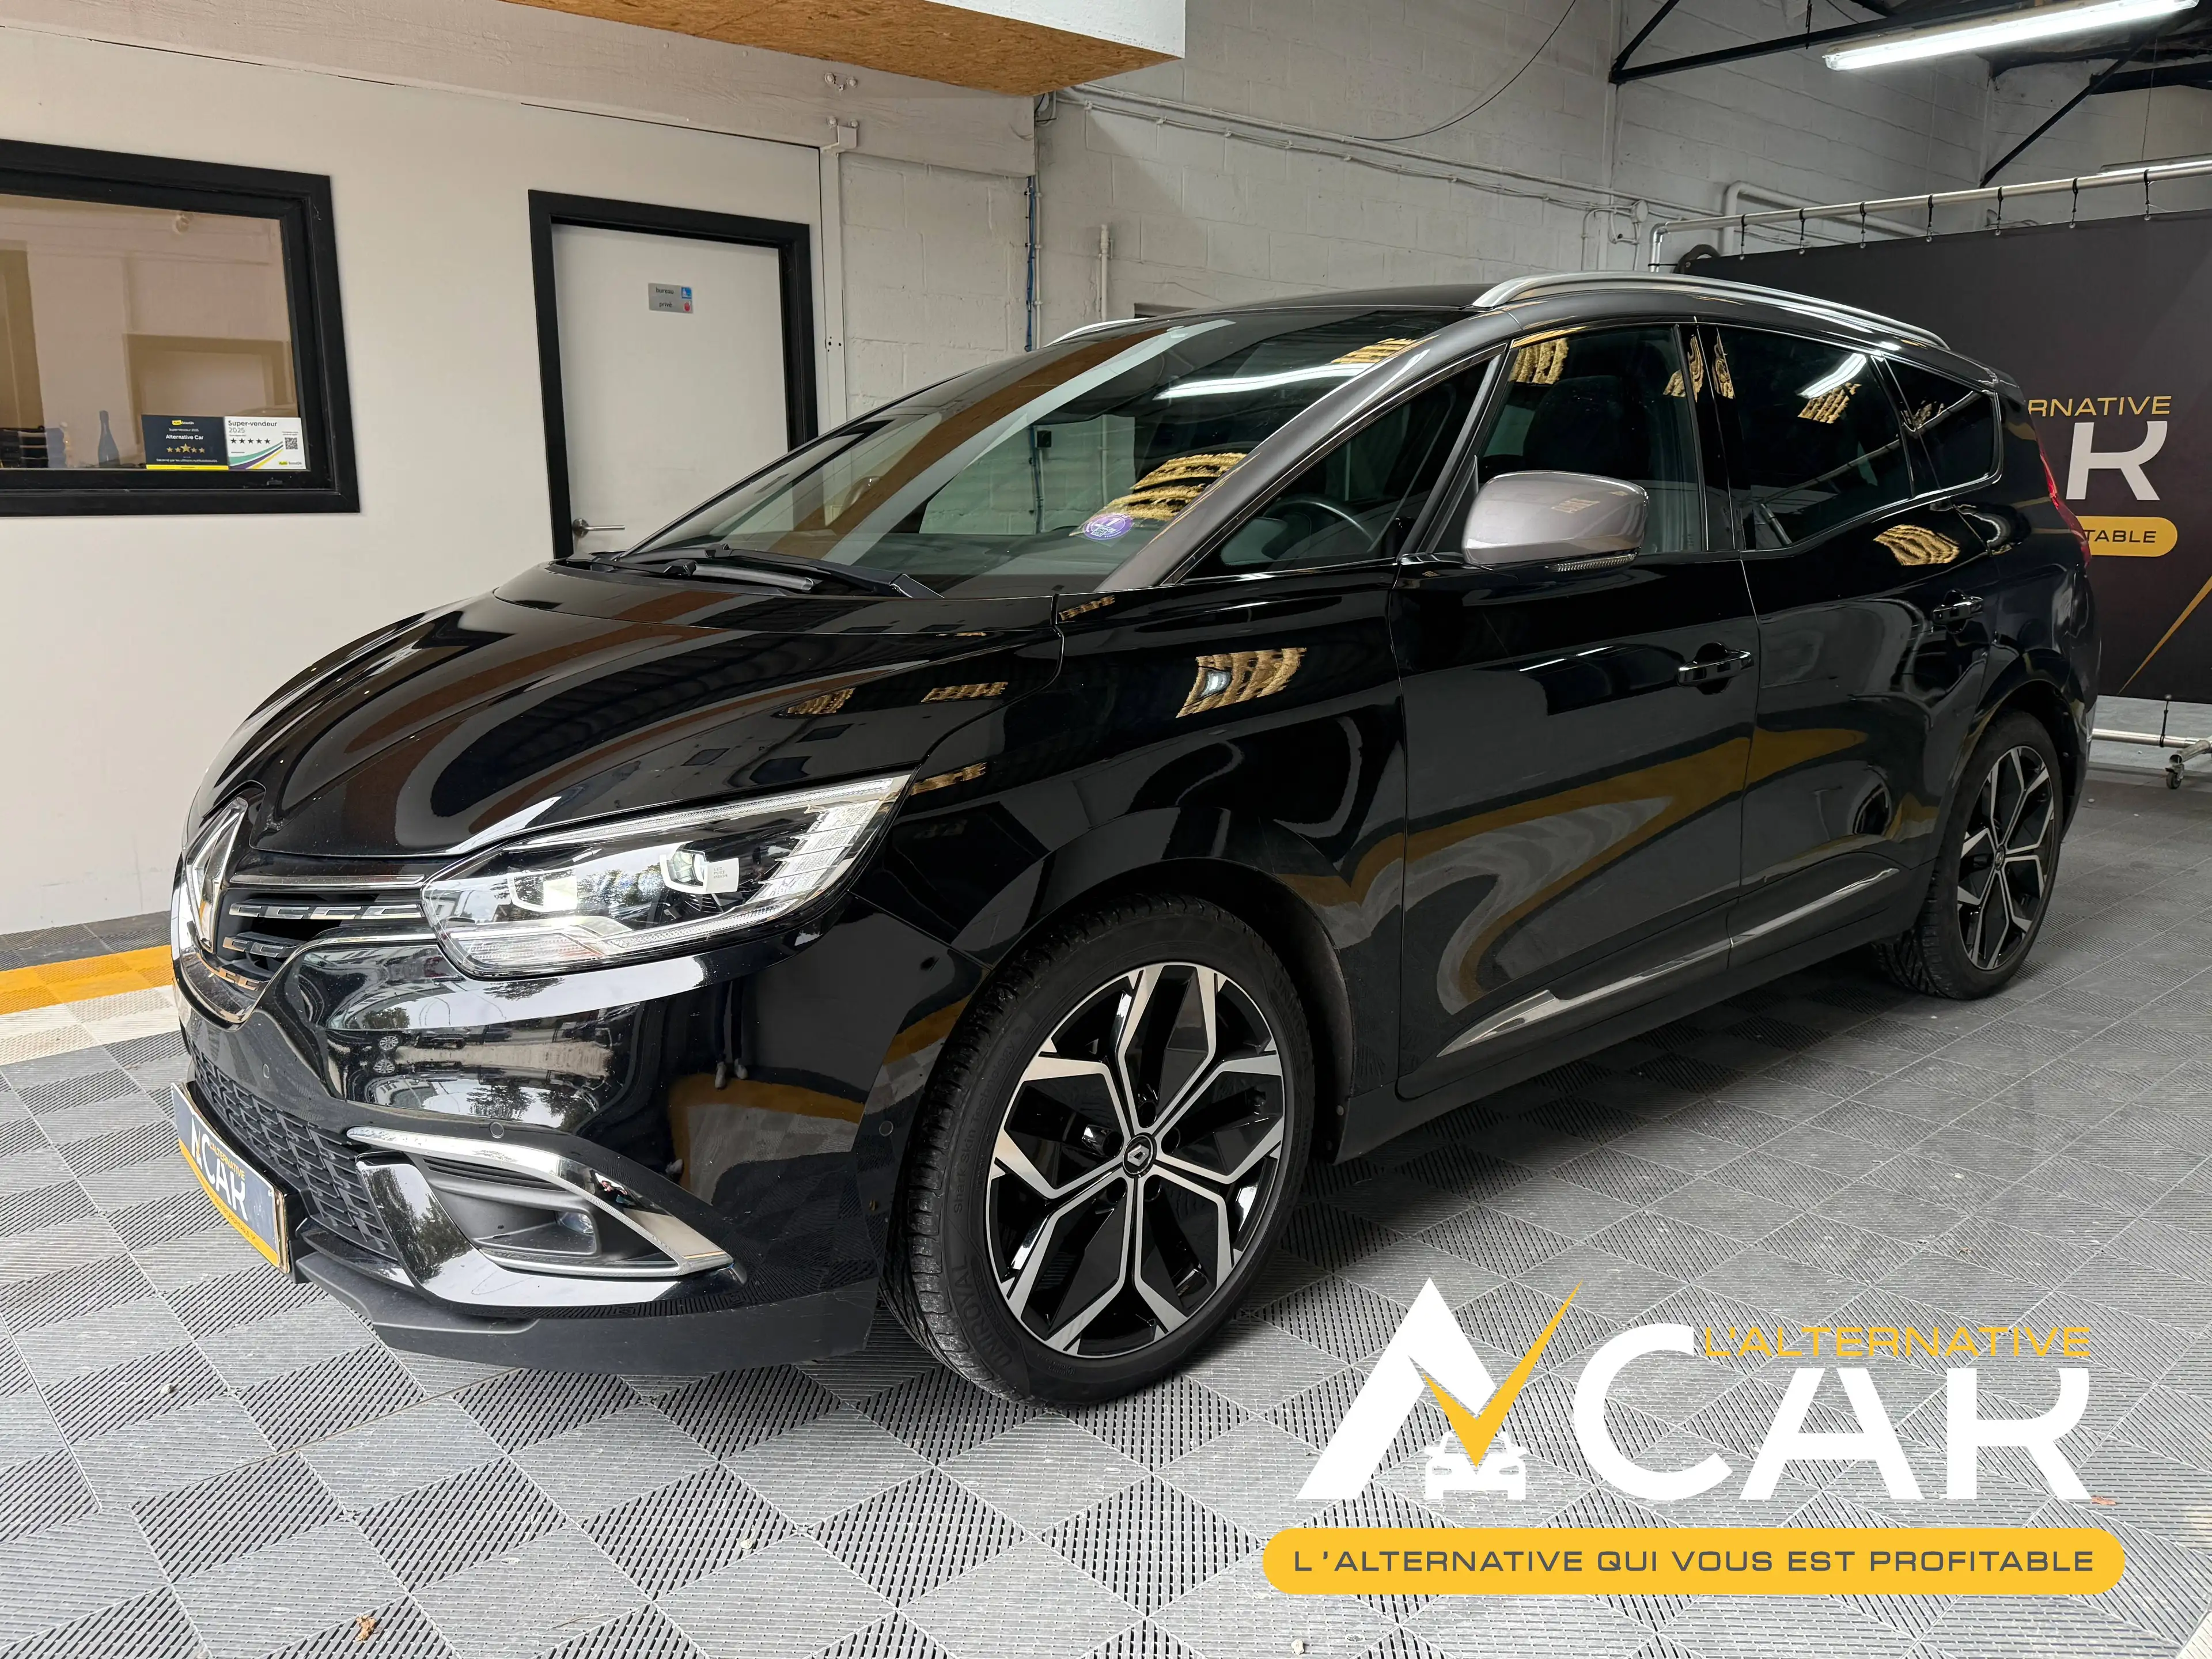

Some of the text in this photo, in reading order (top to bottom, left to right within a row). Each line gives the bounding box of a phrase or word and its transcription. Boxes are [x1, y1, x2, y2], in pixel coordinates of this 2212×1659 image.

[971, 1039, 1016, 1123] Technology
[960, 1129, 976, 1164] Skin
[953, 1167, 968, 1214] Shark
[951, 1255, 1014, 1369] UNIROYAL
